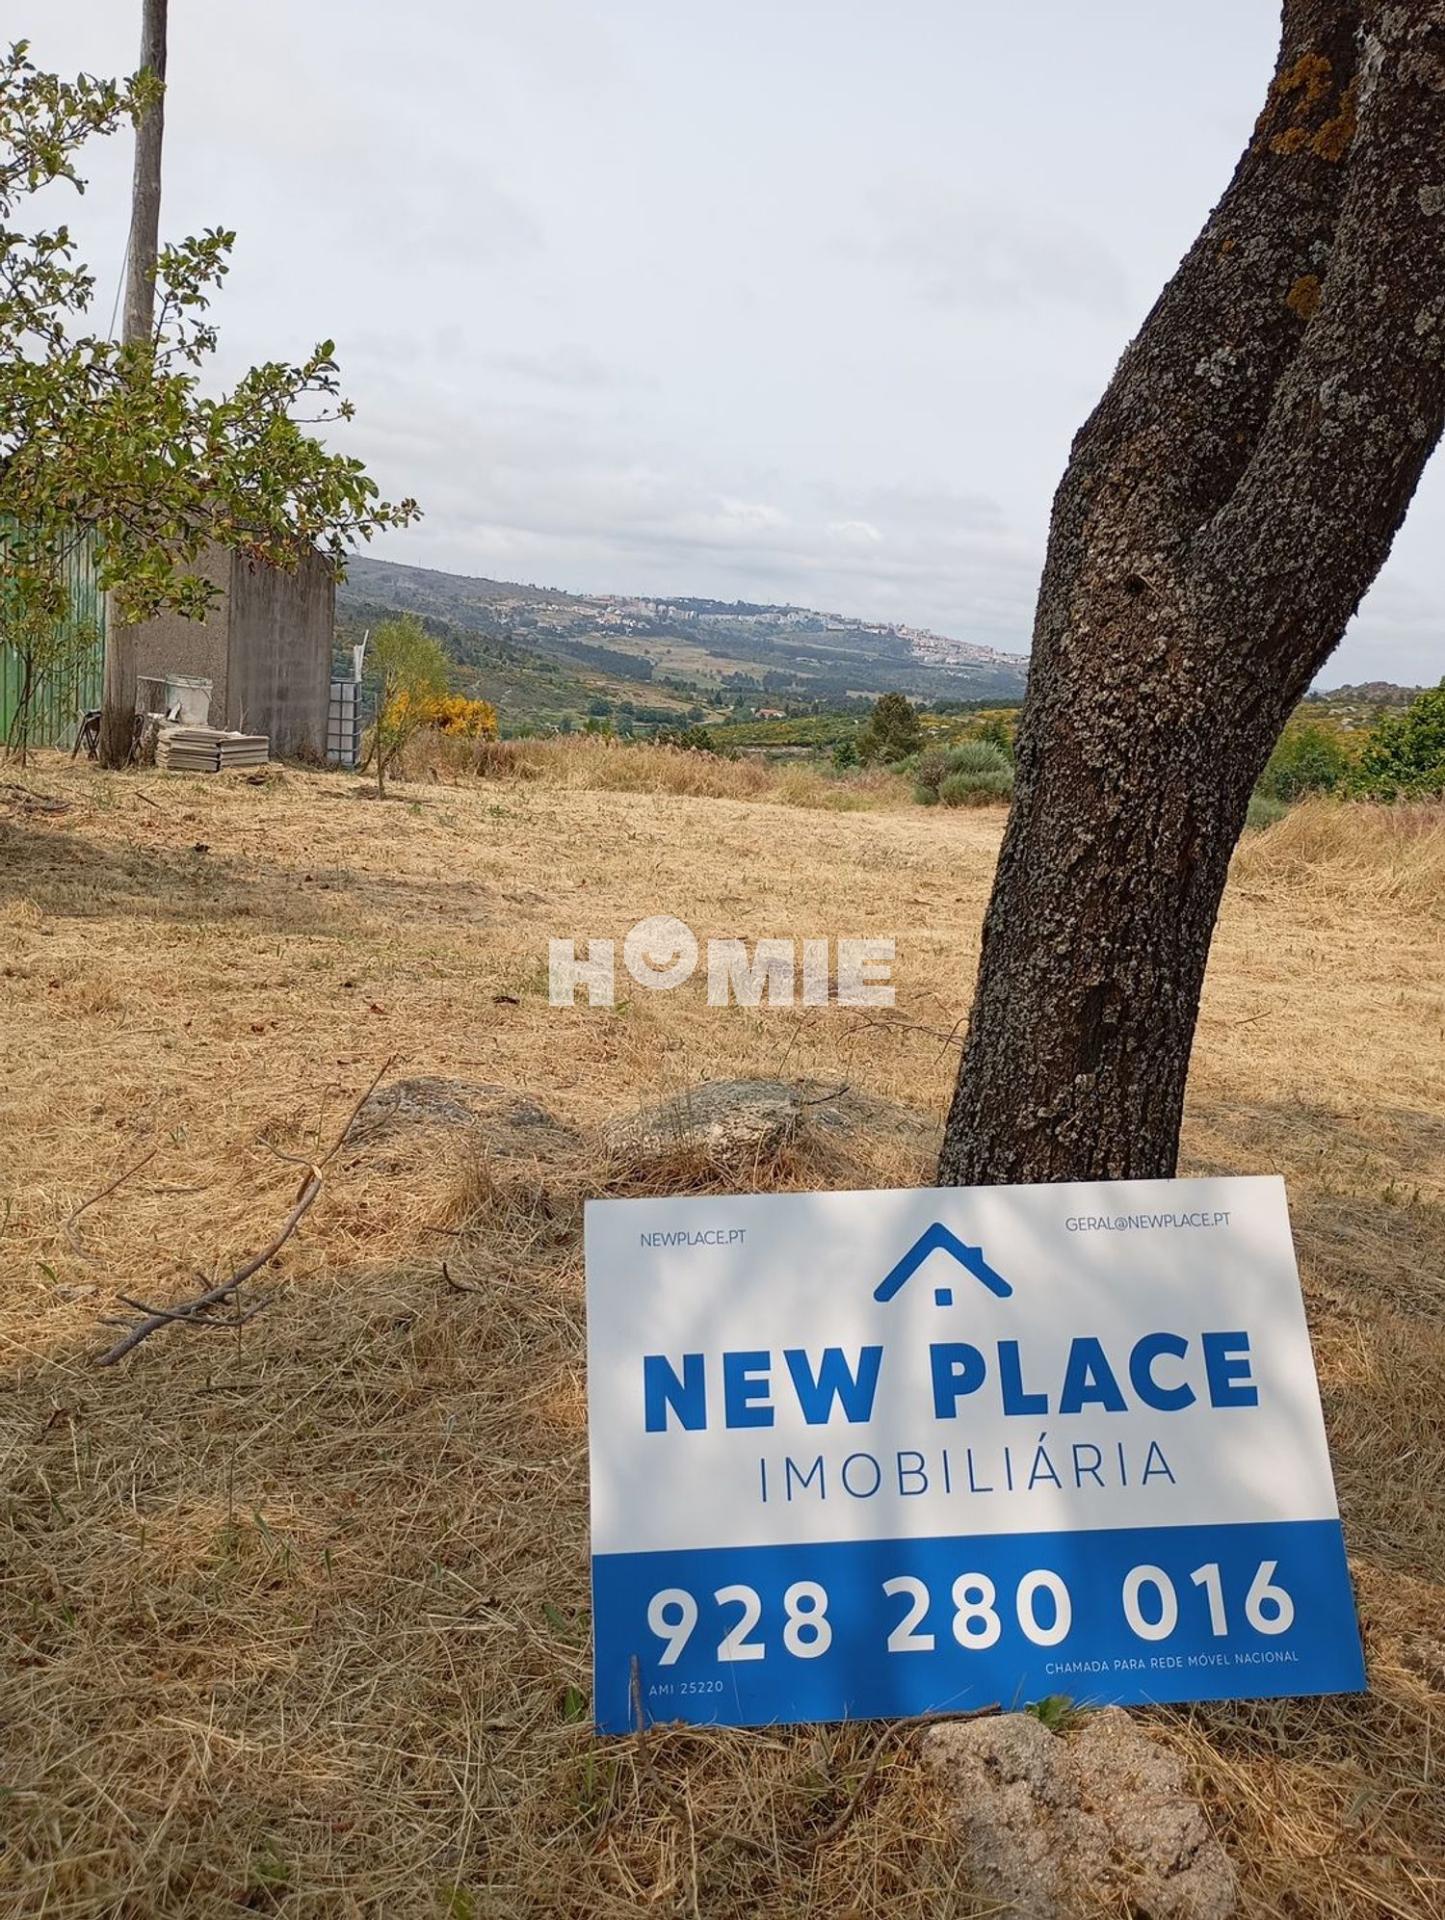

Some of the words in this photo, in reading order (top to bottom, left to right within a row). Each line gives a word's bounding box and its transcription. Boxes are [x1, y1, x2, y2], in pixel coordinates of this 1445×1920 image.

[1065, 1211, 1231, 1232] GERAL@NEWPLACE.PT
[640, 1229, 747, 1248] NEWPLACE.PT
[643, 1345, 884, 1433] NEW
[929, 1330, 1259, 1420] PLACE
[759, 1431, 1177, 1503] IMOBILIÁRIA
[646, 1580, 833, 1666] 928
[881, 1568, 1072, 1653] 280
[1121, 1560, 1296, 1642] 016
[1044, 1659, 1110, 1675] CHAMADA
[1113, 1657, 1146, 1671] PARA
[1150, 1655, 1184, 1669] REDE
[1187, 1651, 1231, 1667] MÓVEL
[1234, 1649, 1300, 1664] NACIONAL
[648, 1682, 675, 1697] AMI
[679, 1680, 725, 1695] 25220
